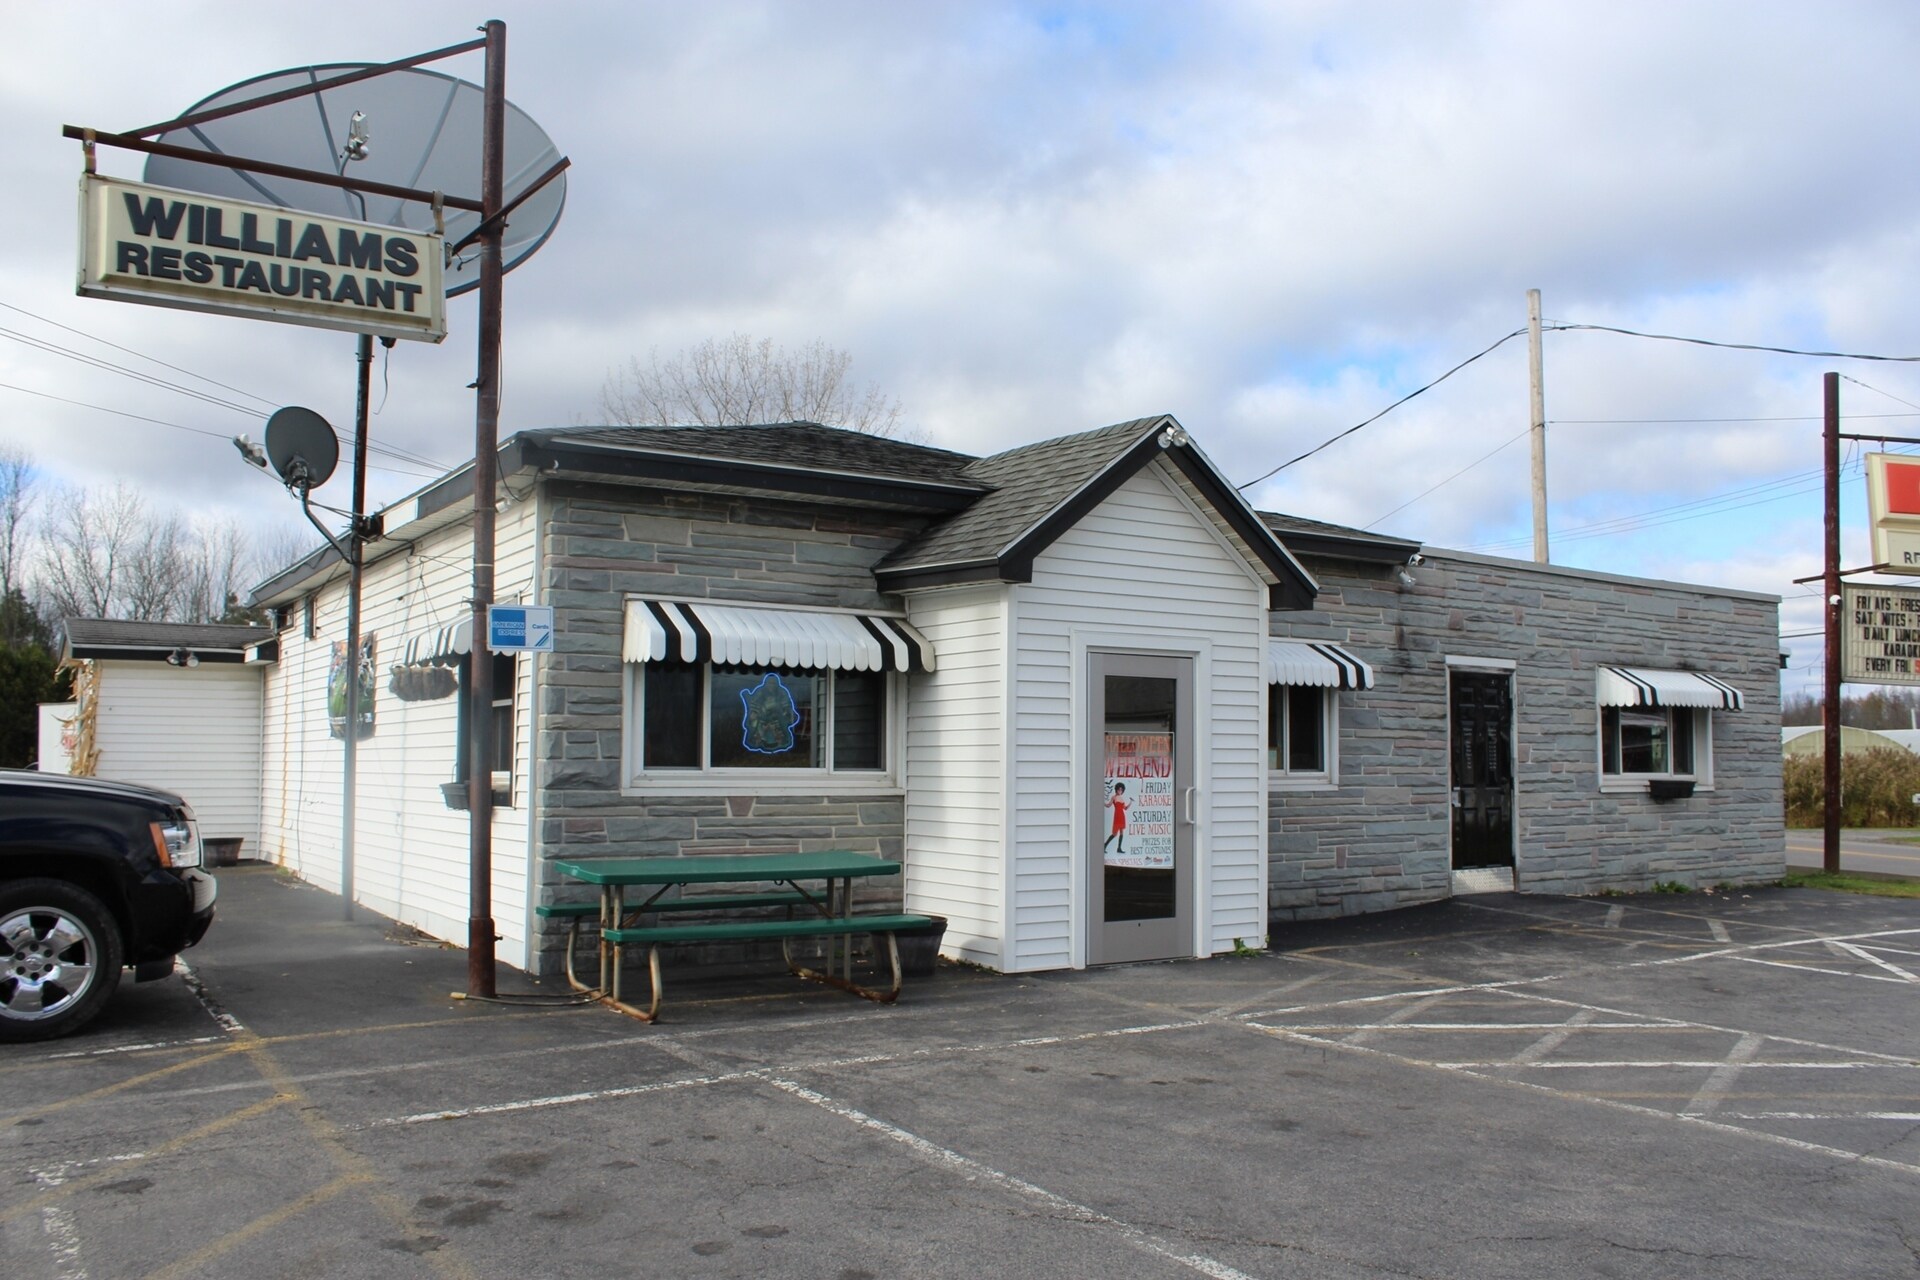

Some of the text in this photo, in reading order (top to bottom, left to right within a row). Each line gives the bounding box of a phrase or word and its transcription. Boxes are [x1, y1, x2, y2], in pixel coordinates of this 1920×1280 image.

[123, 192, 419, 277] WILLIAMS
[116, 240, 422, 312] RESTAURANT
[1864, 627, 1889, 641] DAILY
[1884, 643, 1920, 658] KARAOK
[1866, 657, 1890, 672] EVERY
[1104, 756, 1172, 779] WEEKEND
[1145, 782, 1172, 794] FRIDAY
[1139, 795, 1171, 807] KARAOKE
[1132, 811, 1172, 822] SATURDAY
[1129, 824, 1172, 836] LIVE MUSIC
[1130, 846, 1143, 855] BEST
